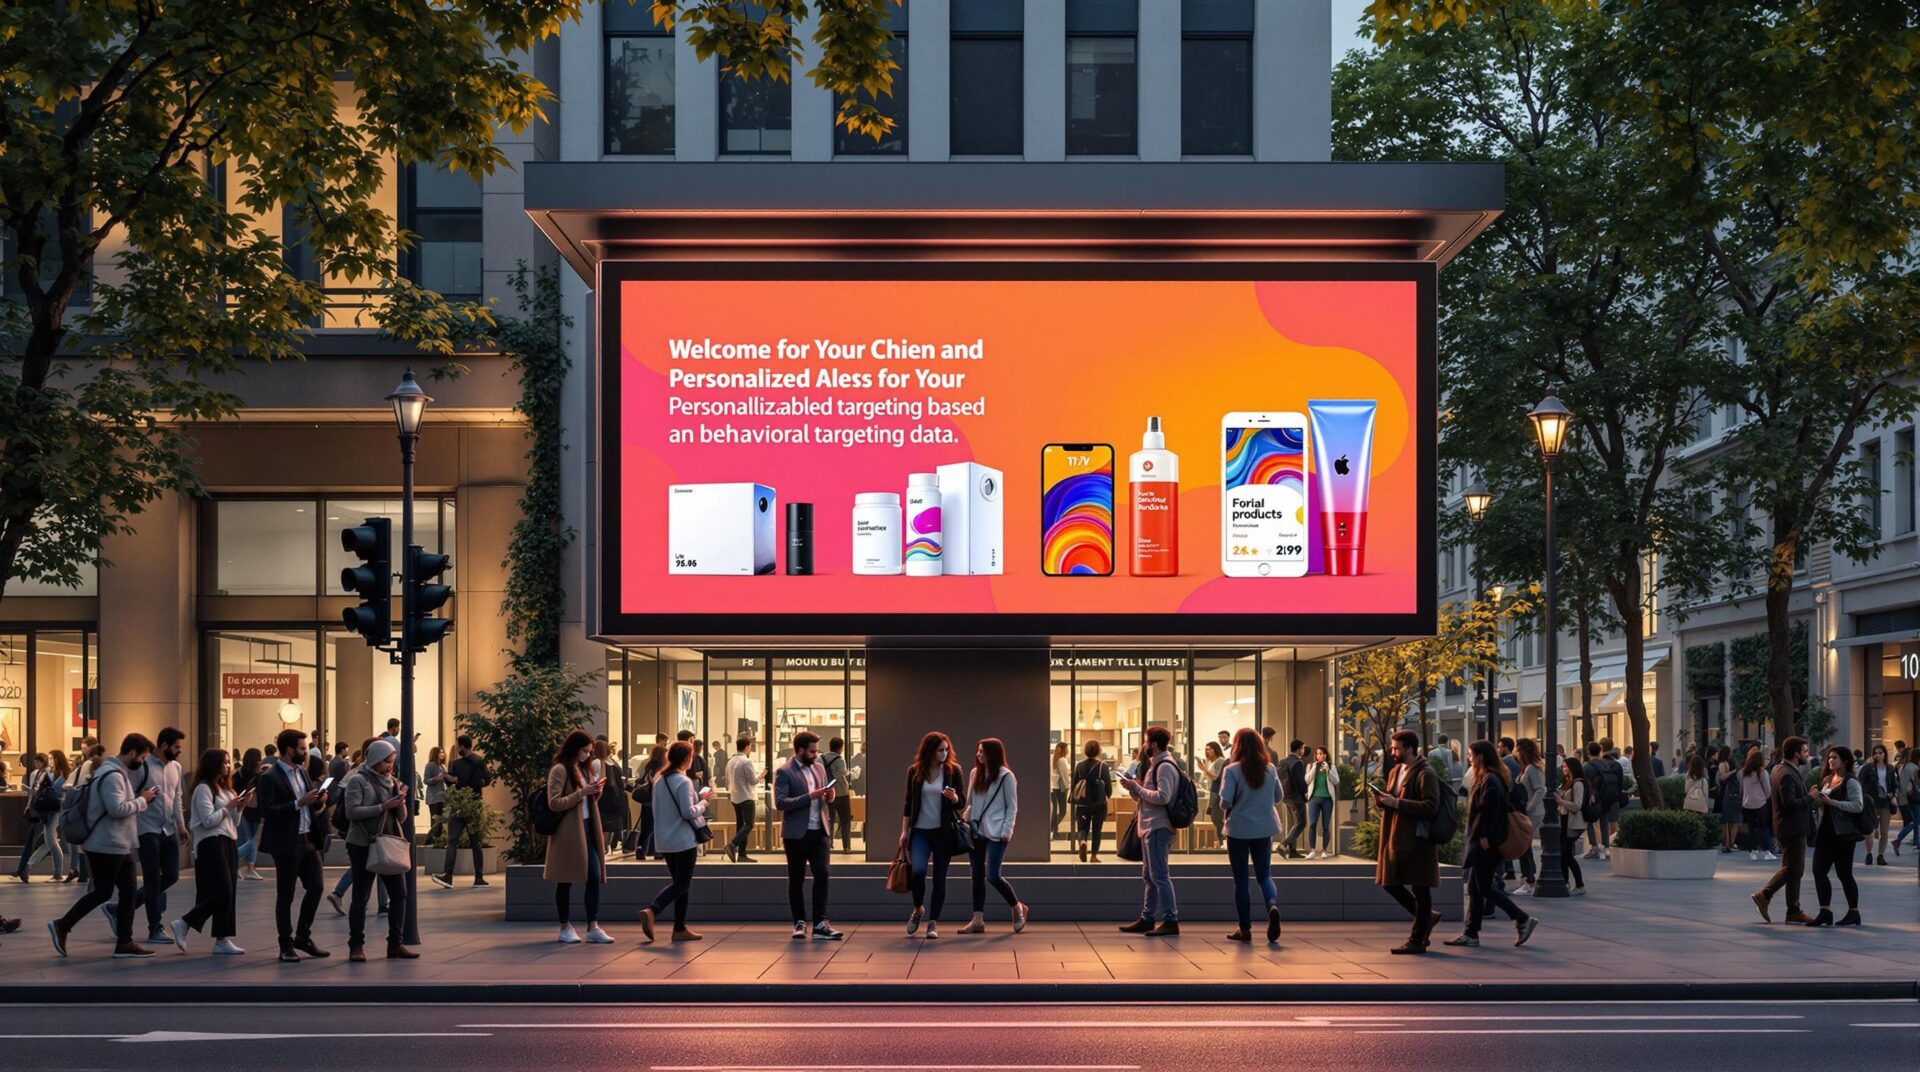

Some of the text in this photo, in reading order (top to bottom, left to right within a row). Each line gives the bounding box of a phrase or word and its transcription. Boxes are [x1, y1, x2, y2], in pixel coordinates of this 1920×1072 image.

[668, 338, 983, 360] Welcome for Your Chien and
[669, 367, 965, 389] Personalized Aless for Your
[837, 397, 922, 420] targeting
[928, 396, 985, 416] based
[669, 423, 959, 448] an behavioral targeting data.
[1232, 498, 1265, 509] Forial
[1232, 509, 1282, 521] products
[786, 658, 818, 667] MOUN
